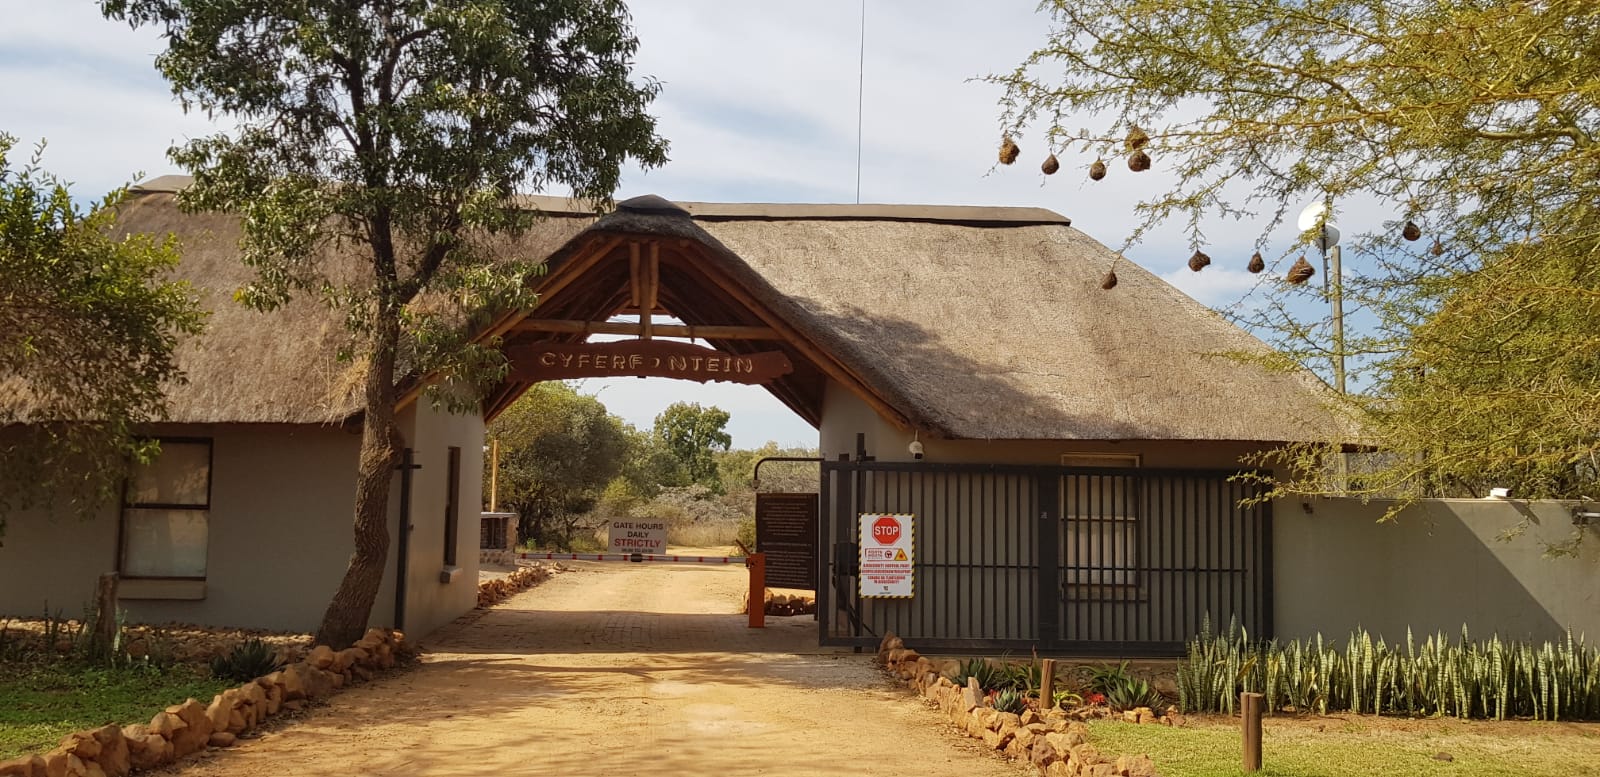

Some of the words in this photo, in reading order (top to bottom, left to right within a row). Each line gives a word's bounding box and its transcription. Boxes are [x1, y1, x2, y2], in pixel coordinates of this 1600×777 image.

[613, 521, 633, 529] GATE
[635, 522, 664, 530] HOURS
[874, 525, 899, 536] STOP
[614, 538, 661, 548] STRICTLY
